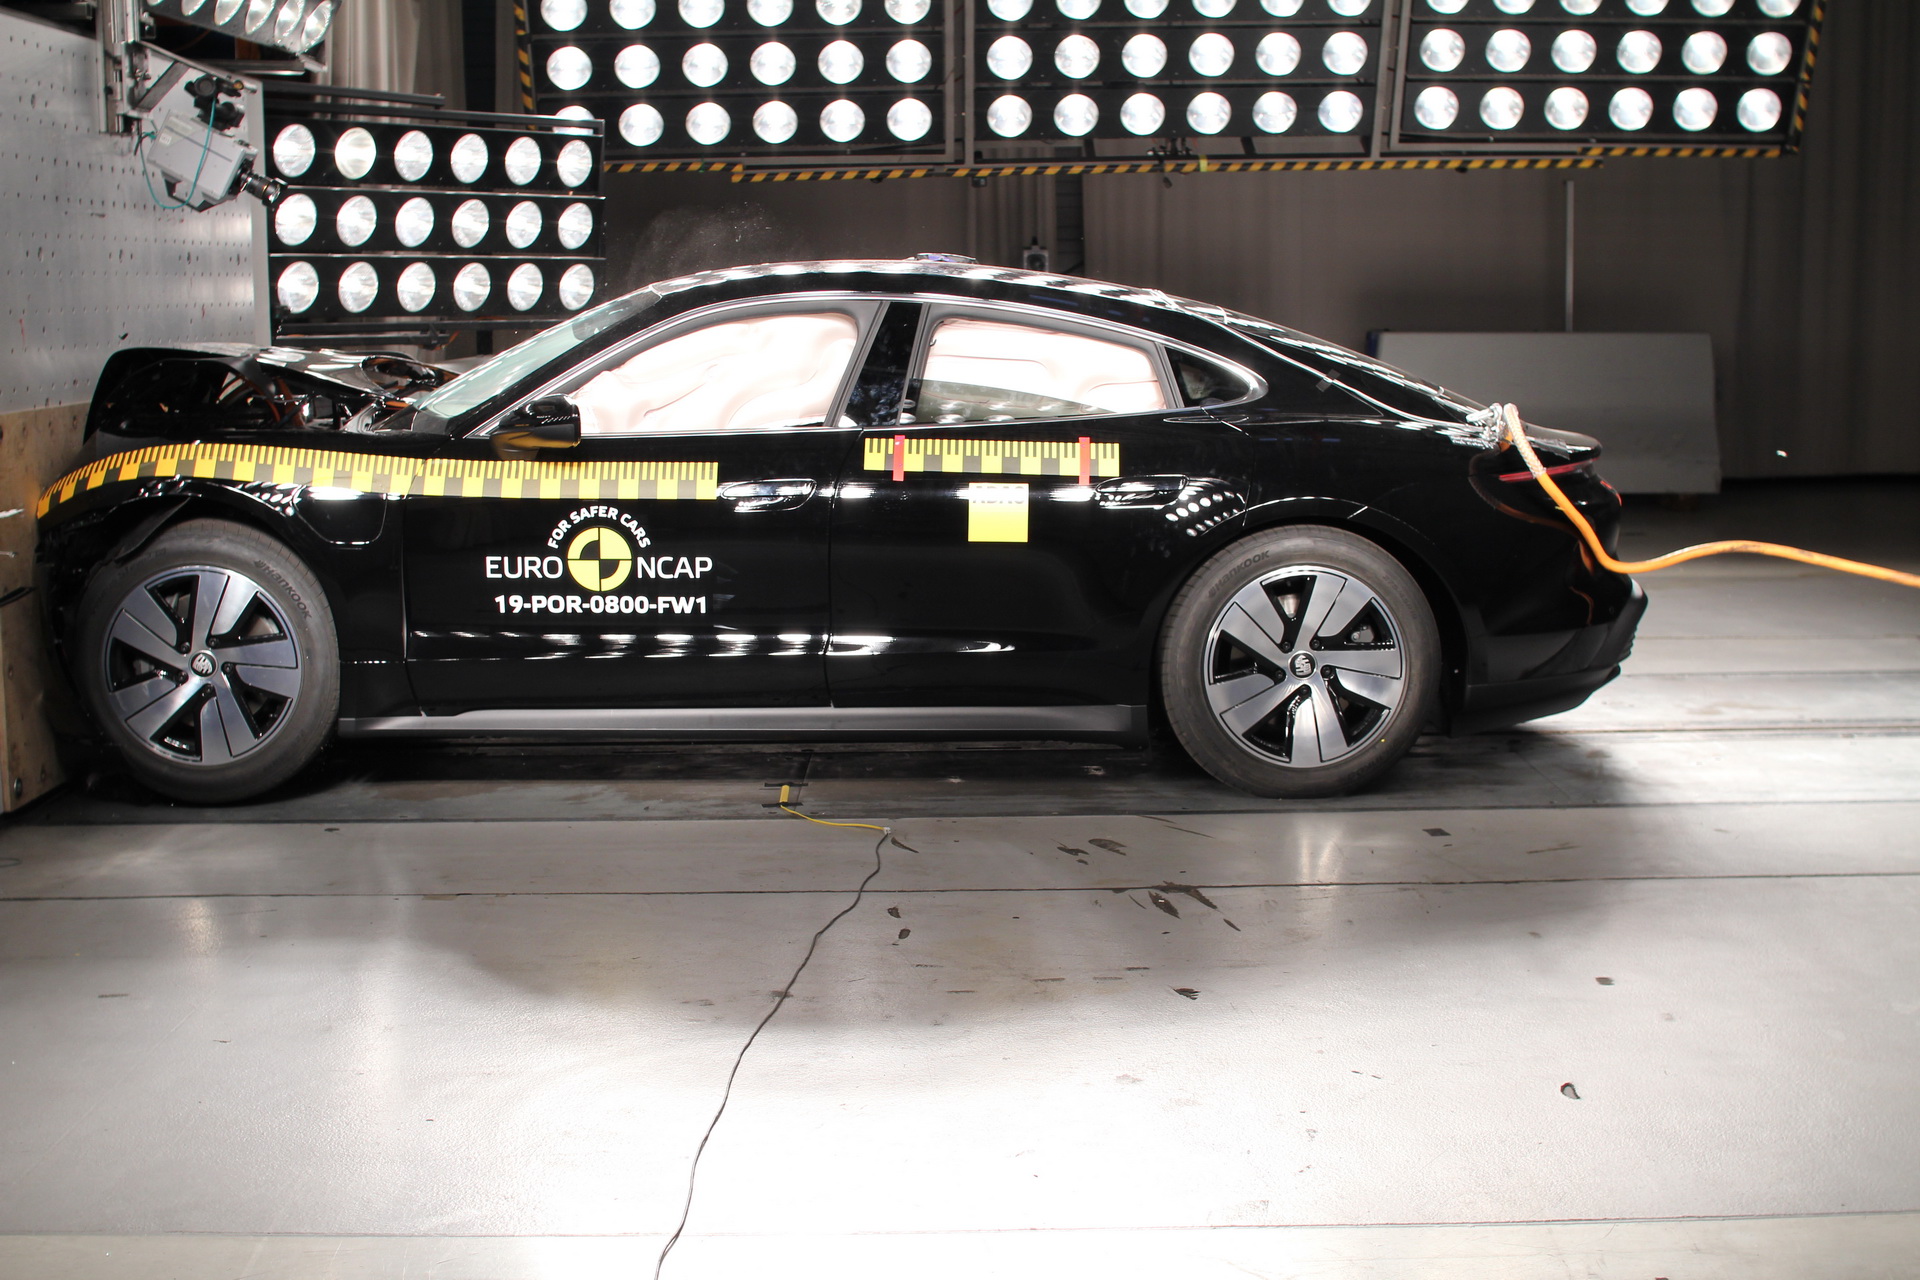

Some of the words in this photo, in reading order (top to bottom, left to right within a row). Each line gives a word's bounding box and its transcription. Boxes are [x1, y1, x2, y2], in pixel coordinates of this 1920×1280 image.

[547, 519, 572, 549] FOR
[569, 505, 619, 525] SAFER
[620, 513, 652, 549] CARS
[485, 556, 564, 579] EURO
[637, 556, 713, 579] NCAP
[494, 594, 707, 614] 19-POR-0800-FW1
